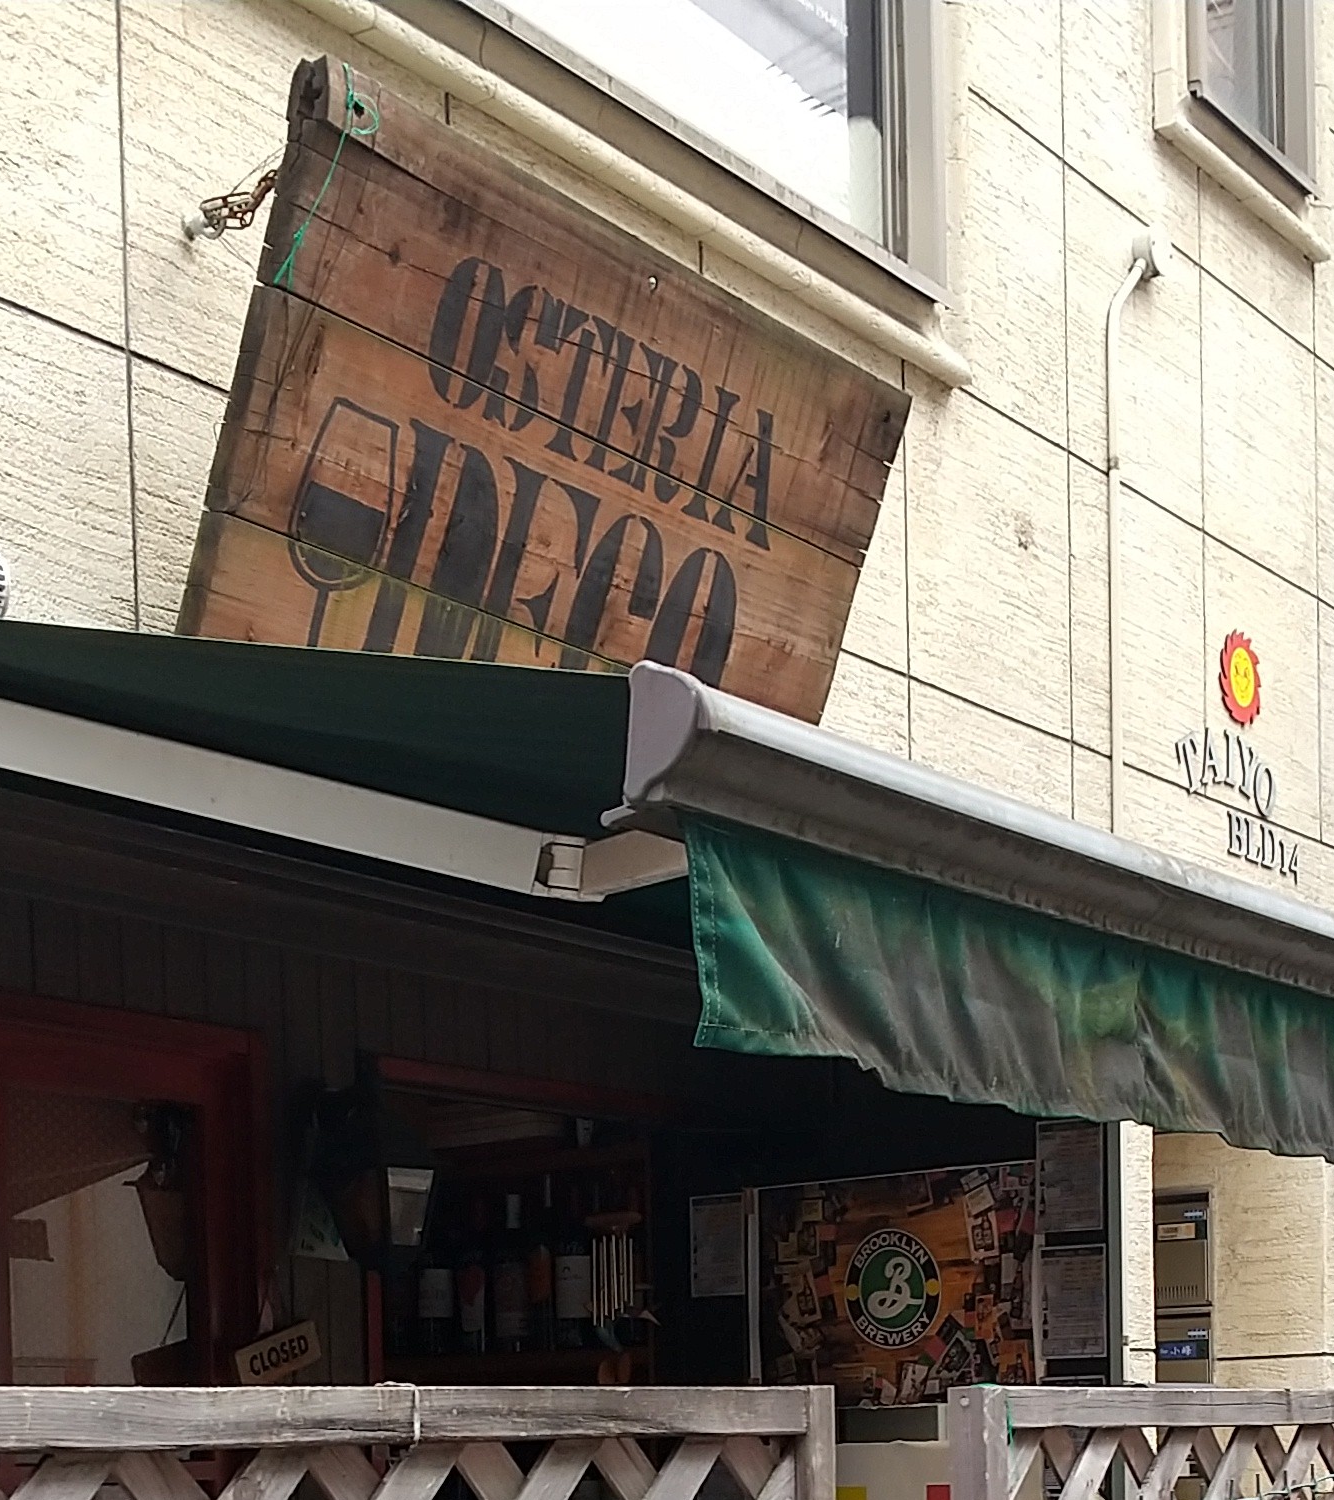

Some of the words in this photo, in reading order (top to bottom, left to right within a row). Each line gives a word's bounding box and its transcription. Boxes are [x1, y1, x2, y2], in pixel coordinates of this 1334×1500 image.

[429, 254, 774, 551] OSTERIA
[1174, 727, 1278, 819] TAIYO
[854, 1232, 929, 1269] BROOKLYN
[856, 1311, 930, 1345] BREWERY
[249, 1334, 309, 1376] CLOSED
